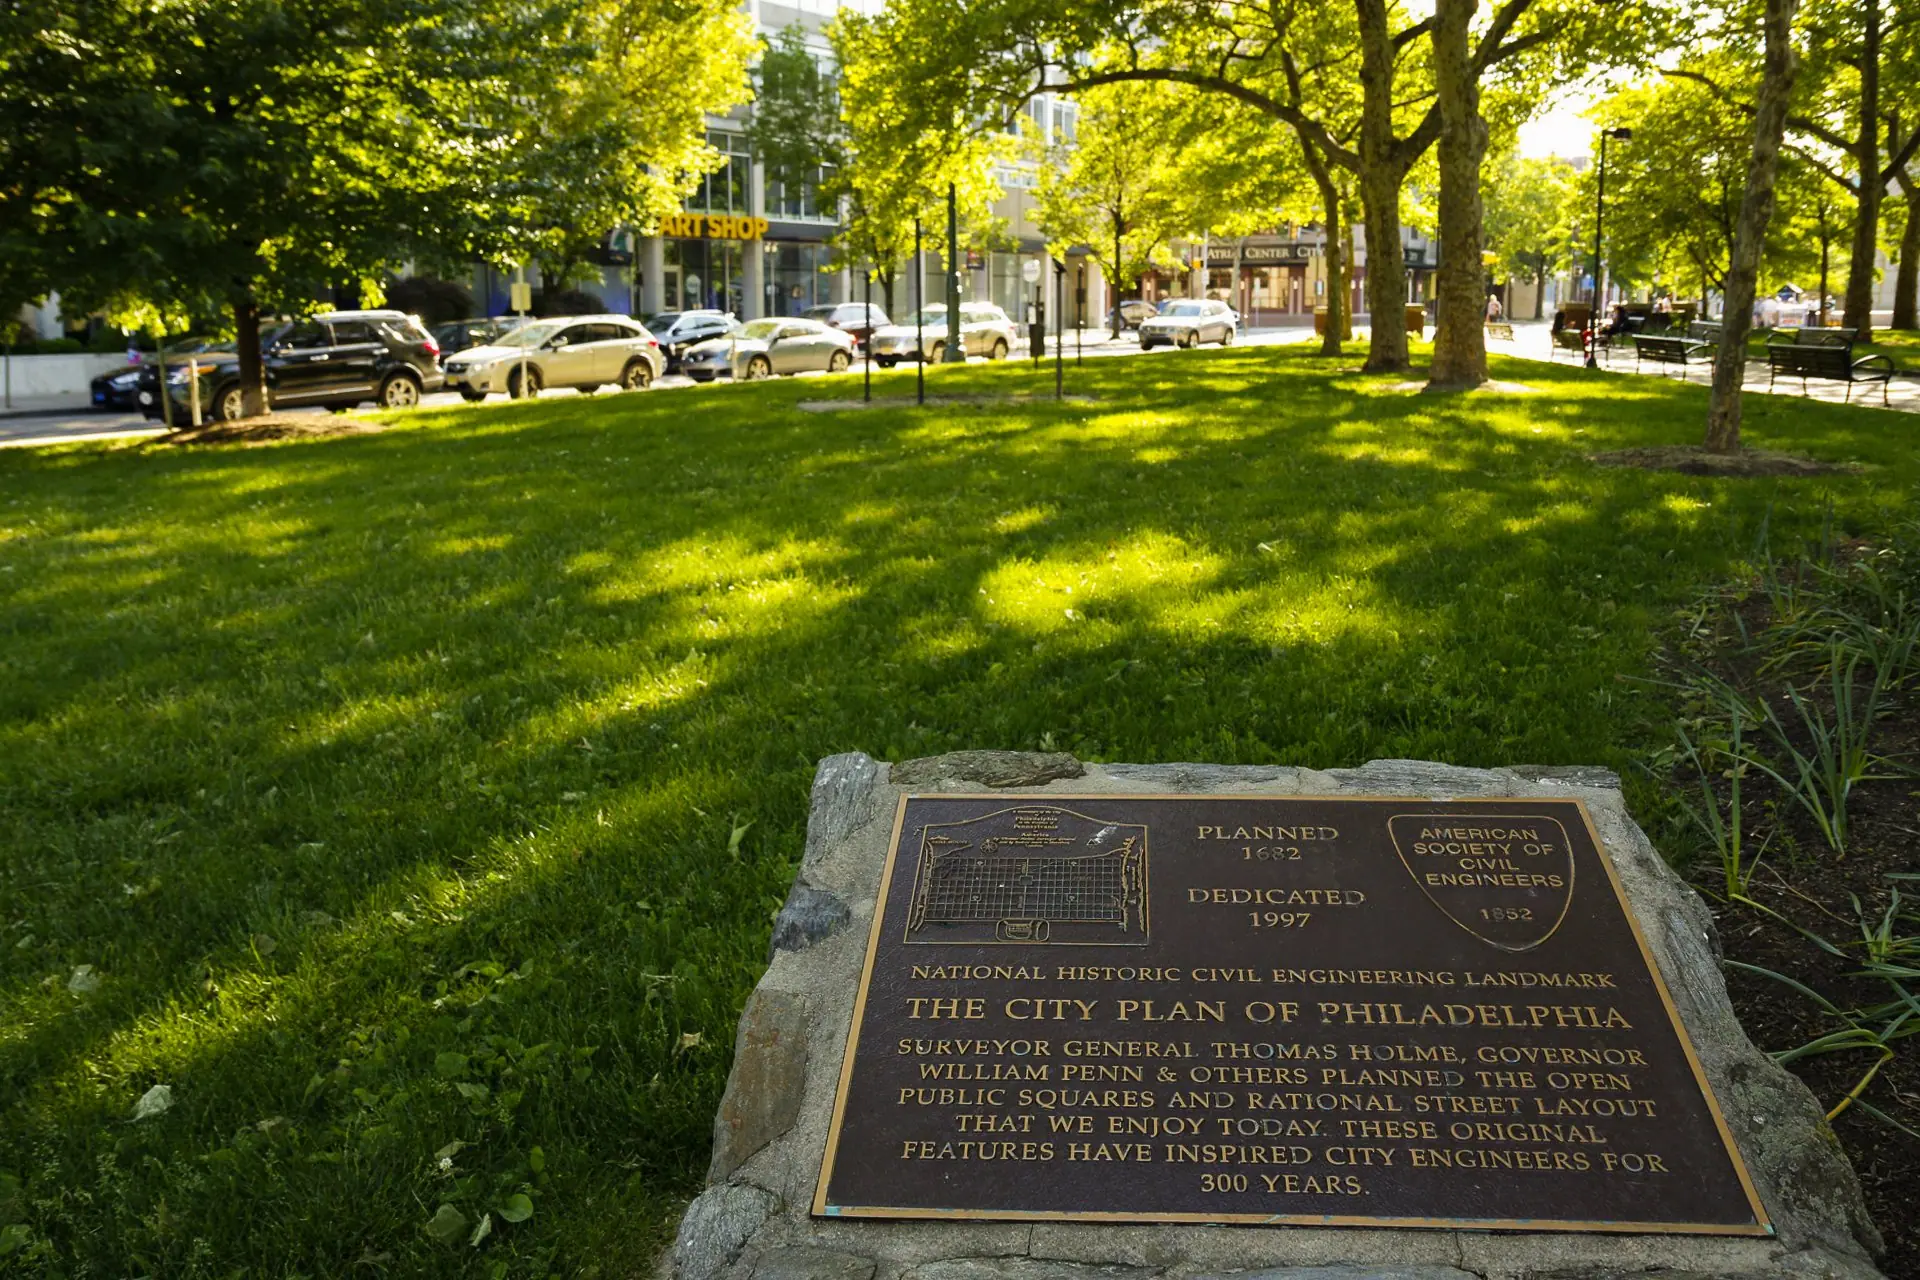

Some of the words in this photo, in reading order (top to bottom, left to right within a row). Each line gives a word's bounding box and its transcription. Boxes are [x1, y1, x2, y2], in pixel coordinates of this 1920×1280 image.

[660, 212, 703, 237] ART
[707, 214, 769, 240] SHOP
[1245, 246, 1290, 259] CENTER
[1196, 826, 1339, 840] PLANNED
[1420, 828, 1539, 840] AMERICAN
[1242, 846, 1302, 861] 1682
[1414, 842, 1511, 855] SOCIETY
[1523, 843, 1554, 856] OF
[1459, 858, 1520, 870] CIVIL
[1426, 873, 1564, 887] ENGINEERS
[1188, 888, 1367, 905] DEDICATED
[1248, 912, 1310, 928] 1997
[1479, 907, 1533, 920] 1852
[911, 966, 1046, 980] NATIONAL
[1056, 967, 1181, 982] HISTORIC
[1192, 968, 1262, 983] CIVIL
[1272, 969, 1455, 985] ENGINEERING
[1464, 972, 1616, 988] LANDMARK
[906, 998, 985, 1020] THE
[1005, 998, 1098, 1021] CITY
[1117, 1000, 1226, 1022] PLAN
[1245, 1001, 1300, 1023] OF
[1318, 1002, 1633, 1028] PHILADELPHIA
[898, 1039, 1050, 1056] SURVEYOR
[1063, 1040, 1198, 1058] GENERAL
[1211, 1042, 1337, 1060] THOMAS
[1348, 1044, 1467, 1065] HOLME,
[1477, 1046, 1648, 1066] GOVERNOR
[919, 1064, 1049, 1080] WILLIAM
[1061, 1065, 1143, 1082] PENN
[1157, 1066, 1177, 1082] &
[1190, 1066, 1308, 1084] OTHERS
[1322, 1068, 1464, 1087] PLANNED
[1475, 1071, 1536, 1088] THE
[1548, 1072, 1632, 1091] OPEN
[898, 1088, 1006, 1106] PUBLIC
[1018, 1089, 1154, 1109] SQUARES
[1168, 1092, 1234, 1108] AND
[1248, 1092, 1402, 1112] RATIONAL
[1415, 1095, 1522, 1114] STREET
[1534, 1098, 1656, 1117] LAYOUT
[956, 1114, 1035, 1132] THAT
[1048, 1116, 1094, 1134] WE
[1108, 1116, 1204, 1138] ENJOY
[1218, 1118, 1328, 1137] TODAY.
[1340, 1120, 1438, 1140] THESE
[1450, 1122, 1607, 1144] ORIGINAL
[901, 1141, 1054, 1160] FEATURES
[1067, 1142, 1152, 1162] HAVE
[1165, 1144, 1313, 1164] INSPIRED
[1325, 1146, 1396, 1166] CITY
[1408, 1148, 1591, 1170] ENGINEERS
[1601, 1152, 1669, 1172] FOR
[1200, 1174, 1248, 1193] 300
[1261, 1174, 1371, 1196] YEARS.
